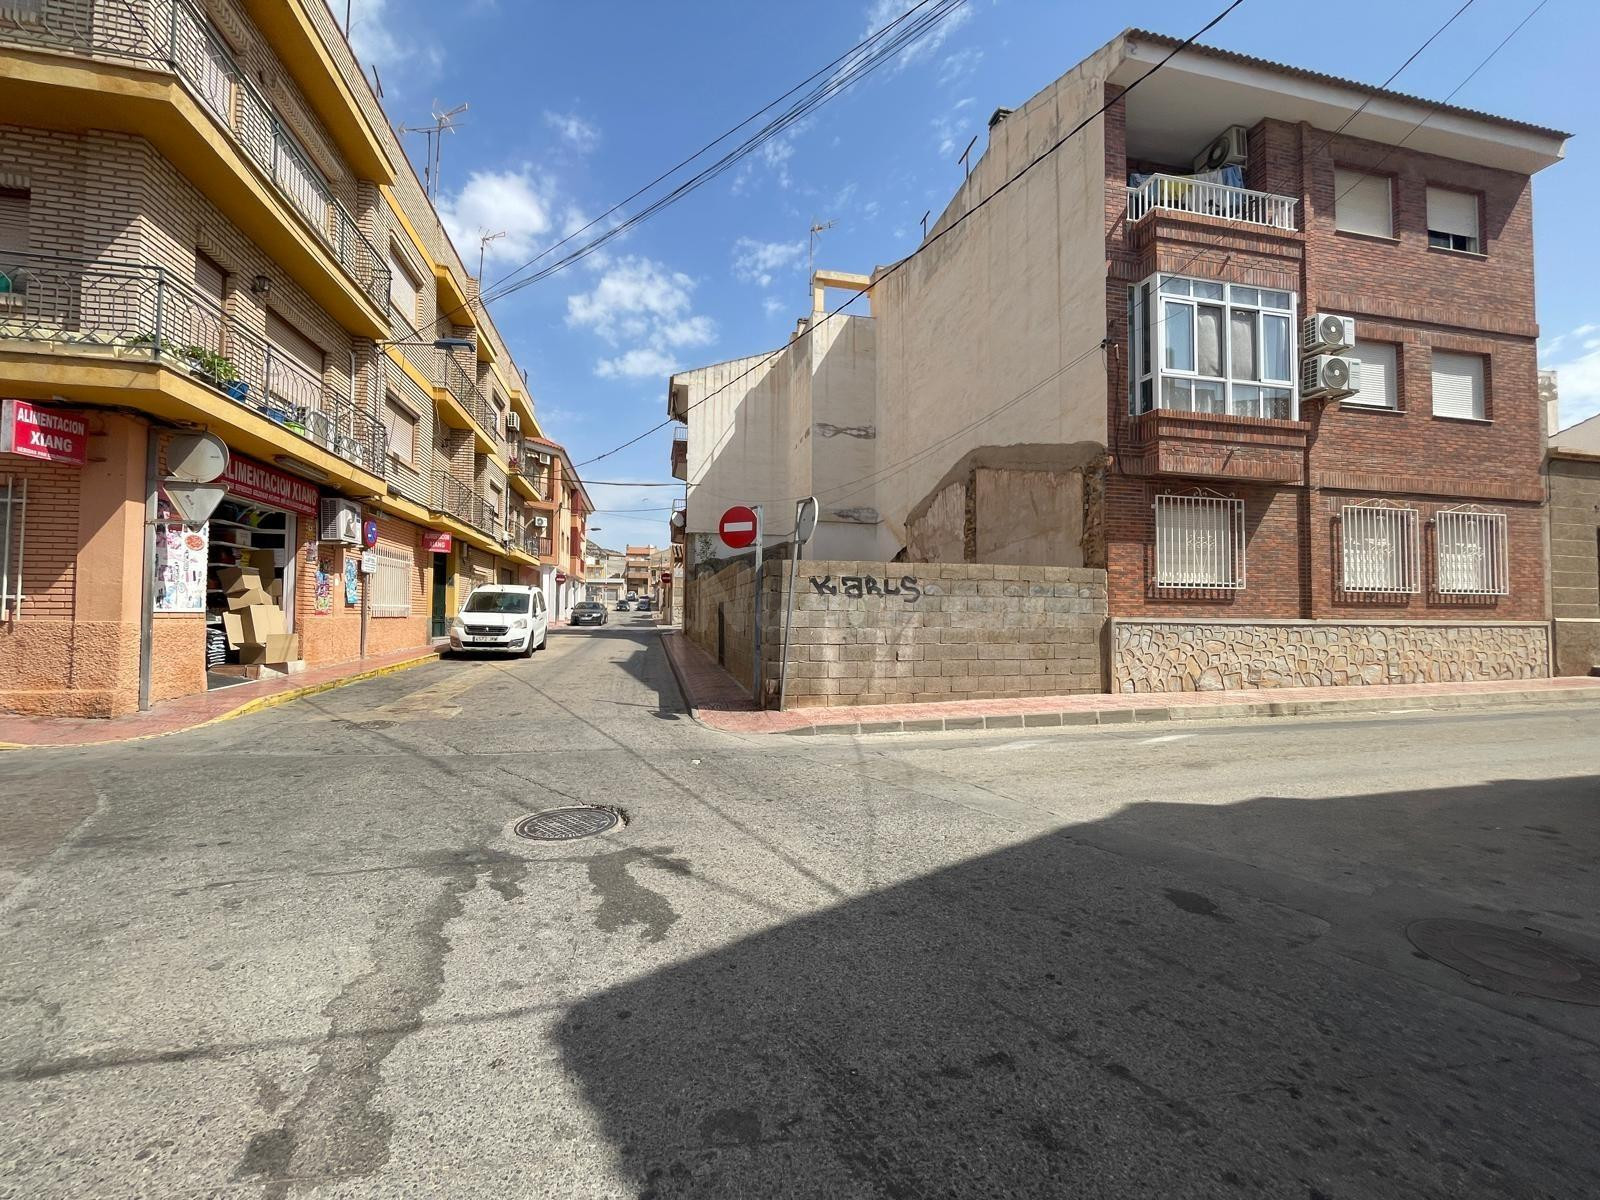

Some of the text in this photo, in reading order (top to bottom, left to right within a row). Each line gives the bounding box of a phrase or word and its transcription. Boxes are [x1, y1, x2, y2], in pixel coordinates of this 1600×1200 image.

[17, 407, 85, 436] ALIMENTACION
[30, 430, 73, 452] XIANG
[292, 482, 318, 506] XIANG
